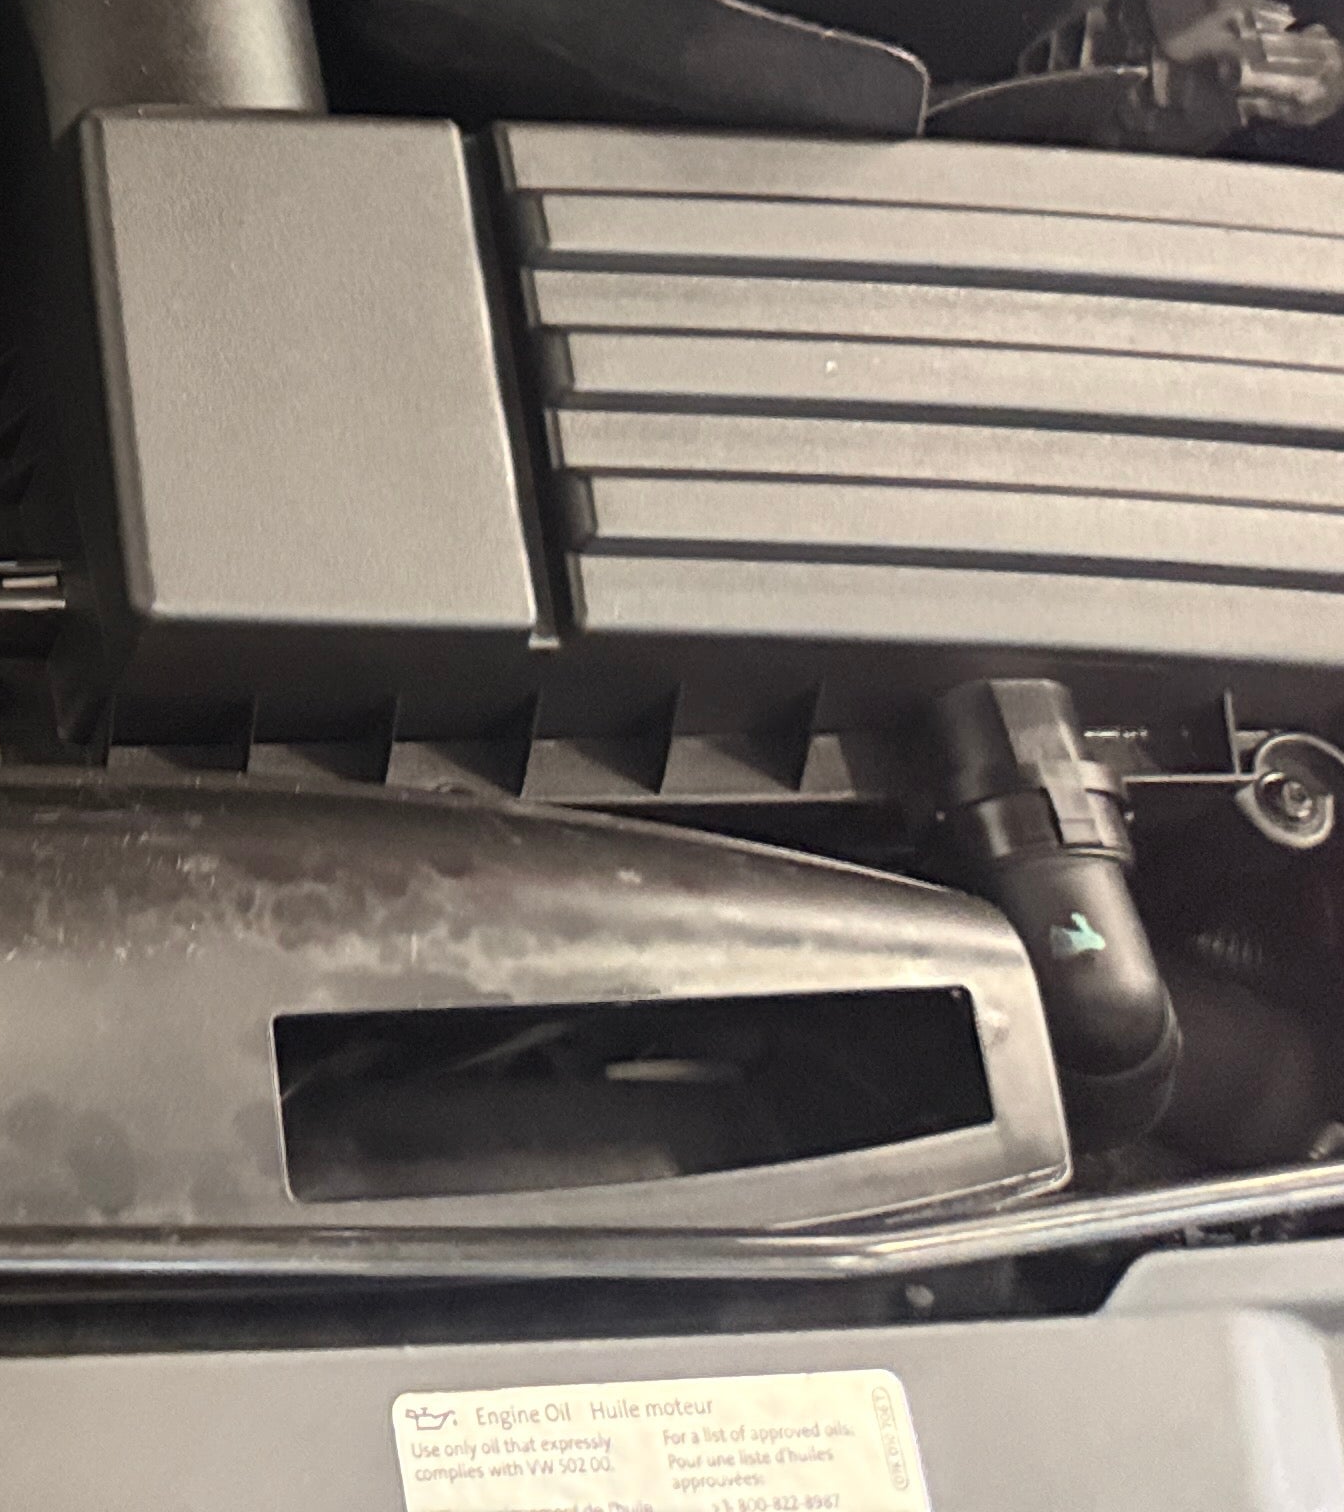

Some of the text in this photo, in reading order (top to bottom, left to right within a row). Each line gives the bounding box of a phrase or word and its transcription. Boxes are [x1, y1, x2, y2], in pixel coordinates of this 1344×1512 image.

[475, 1402, 572, 1430] Engine Oil
[590, 1399, 714, 1420] Huile moteur
[411, 1433, 613, 1461] Use only oil that expressly
[662, 1428, 686, 1446] For
[690, 1431, 700, 1445] a
[702, 1426, 727, 1443] list
[730, 1424, 746, 1442] of
[750, 1422, 820, 1445] approved
[415, 1462, 485, 1485] complies
[488, 1458, 524, 1478] with
[526, 1457, 554, 1475] VW
[558, 1456, 588, 1474] 502
[668, 1445, 835, 1470] Pour une liste d'huiles
